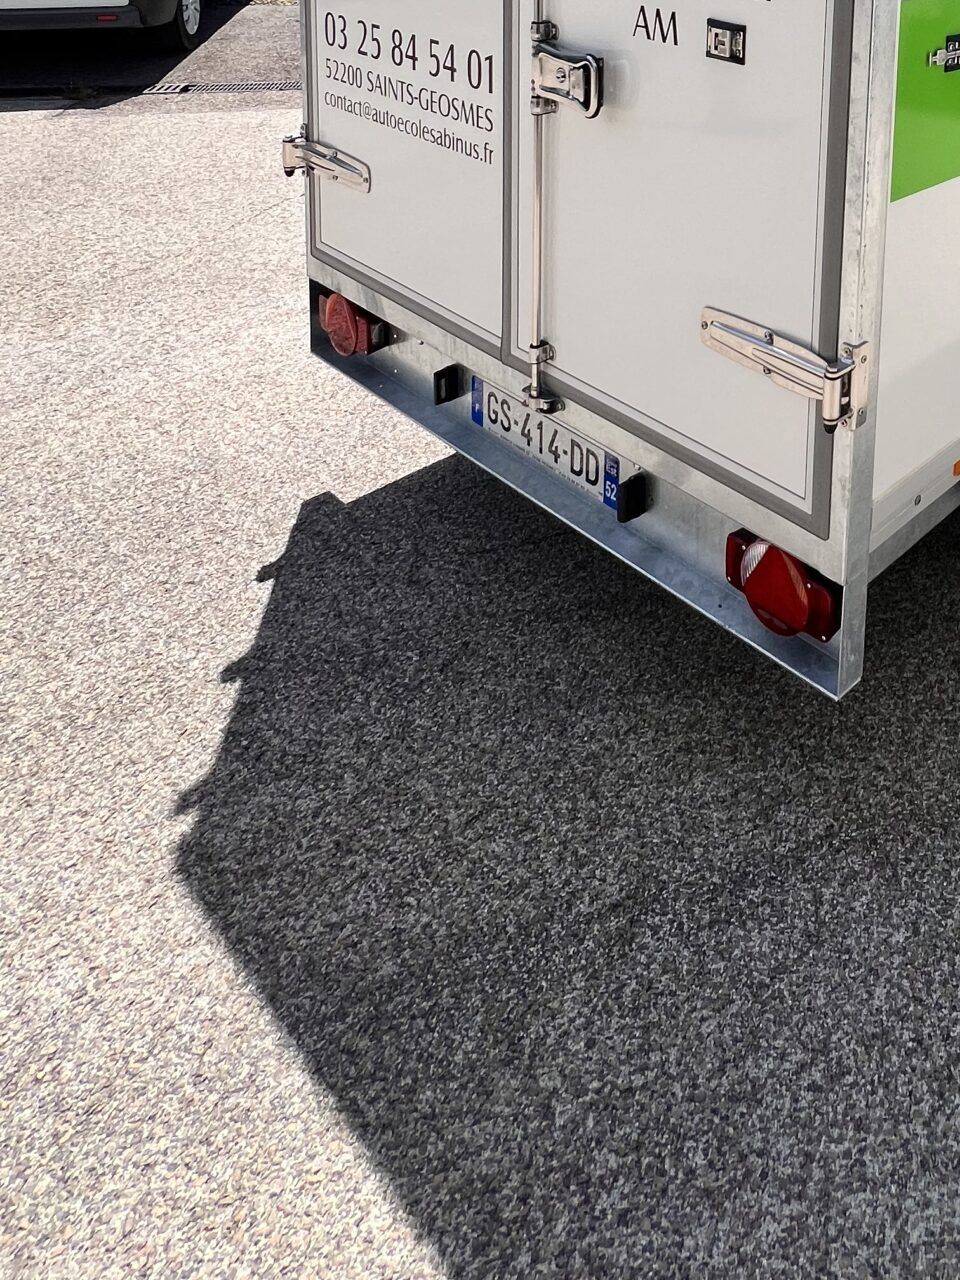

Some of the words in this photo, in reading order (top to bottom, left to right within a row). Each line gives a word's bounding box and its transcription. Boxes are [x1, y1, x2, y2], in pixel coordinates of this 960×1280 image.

[324, 11, 348, 50] 03
[357, 20, 381, 60] 25
[391, 29, 419, 71] 84
[429, 38, 457, 83] 54
[467, 48, 494, 94] 01
[632, 5, 679, 47] AM
[324, 91, 495, 165] contact@autoecolesabinus.fr
[325, 57, 363, 89] 52200
[366, 70, 494, 132] SAINTS-GEOSMES
[487, 390, 600, 487] GS-414-DD
[604, 480, 617, 501] 52
